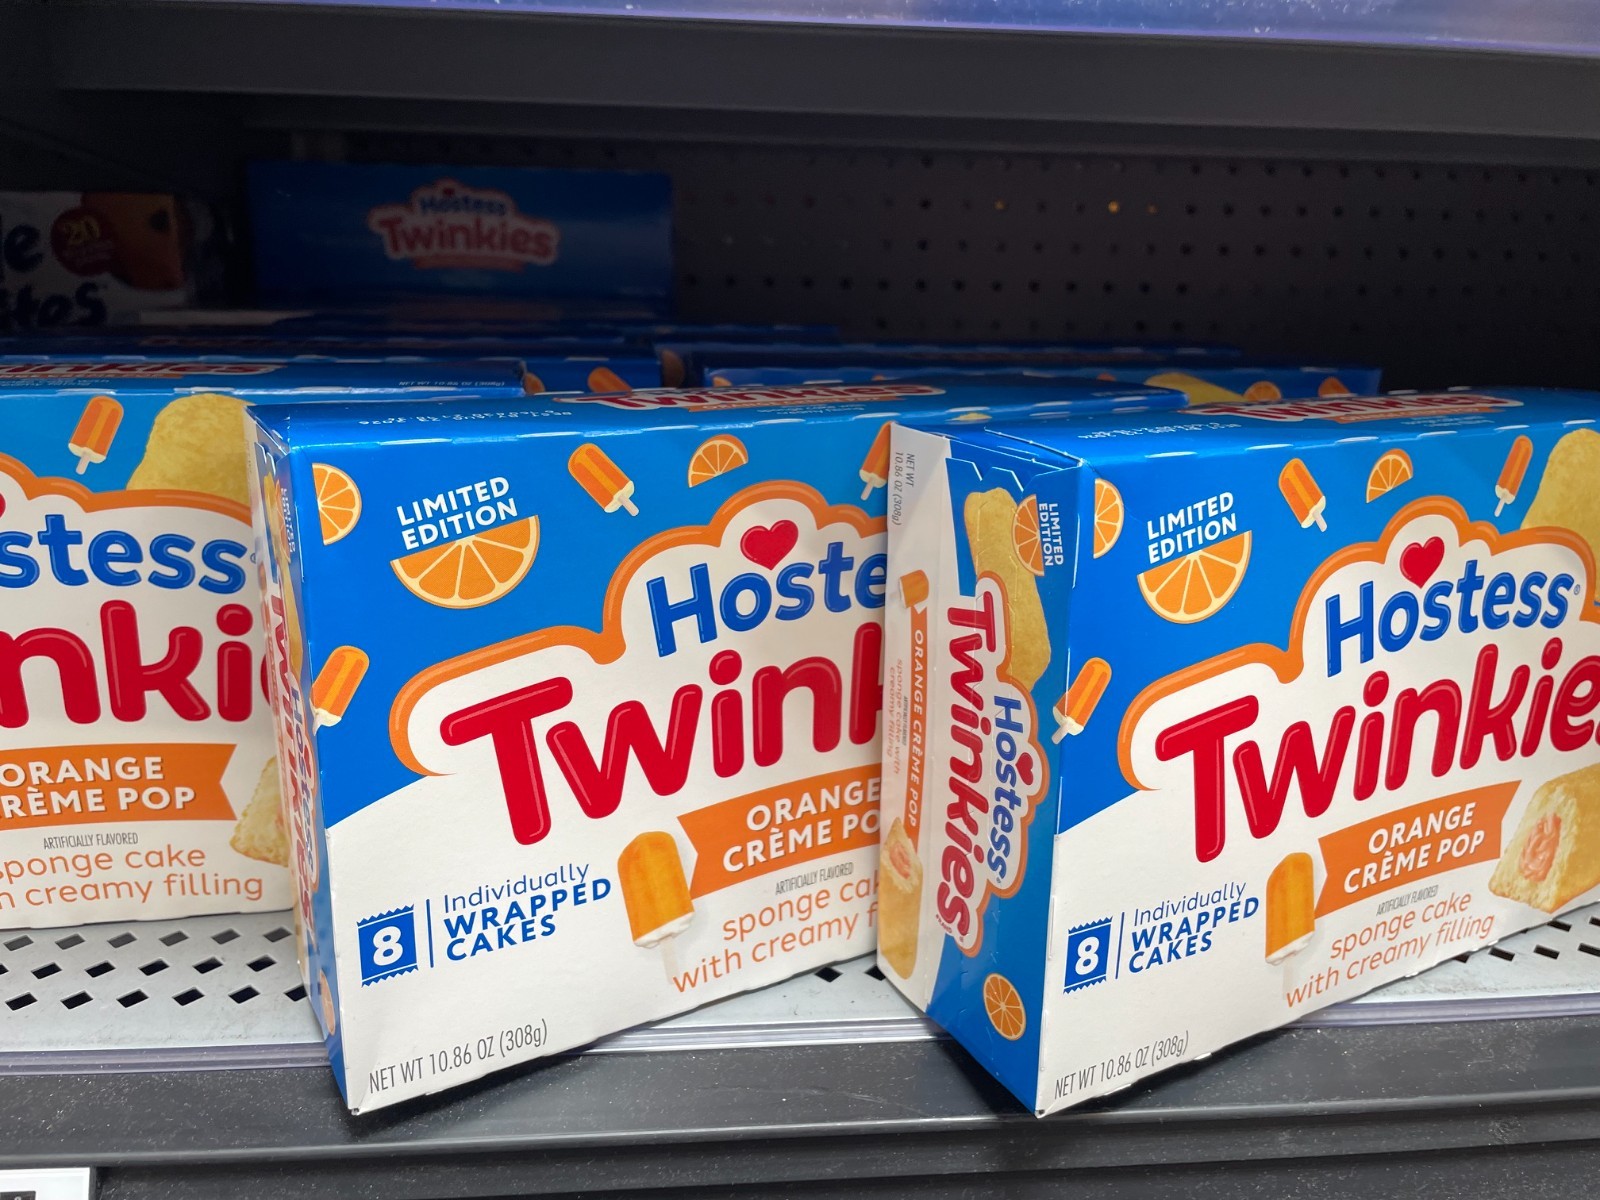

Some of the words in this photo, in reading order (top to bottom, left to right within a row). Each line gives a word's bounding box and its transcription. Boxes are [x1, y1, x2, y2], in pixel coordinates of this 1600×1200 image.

[63, 215, 102, 247] 20
[378, 215, 552, 257] Twinkies
[576, 384, 935, 408] Twinkies
[895, 451, 905, 478] 10.86
[895, 480, 904, 493] OZ
[905, 471, 915, 487] WT
[906, 452, 916, 471] NET
[396, 476, 510, 526] LIMITED
[402, 498, 518, 550] EDITION
[891, 493, 904, 527] (308g)
[1147, 491, 1234, 540] LIMITED
[0, 514, 248, 594] stess
[1038, 502, 1054, 567] EDITION
[1048, 503, 1064, 566] LIMITED
[1148, 513, 1237, 564] EDITION
[646, 541, 886, 658] Hoste
[1325, 559, 1575, 678] Hostess
[0, 600, 273, 728] nki
[912, 629, 925, 718] ORANGE
[894, 710, 904, 743] cake
[910, 719, 924, 781] CRÈME
[1155, 637, 1600, 862] Twinkie
[0, 756, 164, 787] ORANGE
[893, 745, 903, 775] with
[936, 590, 997, 937] Twinkies
[118, 786, 195, 811] POP
[746, 777, 881, 832] ORANGE
[908, 787, 919, 828] POP
[986, 695, 1024, 882] Hostess
[43, 834, 94, 850] ARTIFICIALLY
[96, 832, 139, 846] FLAVORED
[722, 819, 833, 873] CRÈME
[1367, 802, 1476, 855] ORANGE
[125, 844, 206, 869] cake
[775, 870, 818, 895] ARTIFICIALLY
[818, 861, 854, 886] FLAVORED
[1343, 843, 1432, 894] CRÈME
[1436, 830, 1485, 864] POP
[25, 880, 153, 906] creamy
[163, 873, 263, 901] filling
[443, 863, 590, 914] Individually
[443, 878, 611, 939] WRAPPED
[1134, 881, 1247, 927] Individually
[1376, 892, 1412, 916] ARTIFICIALLY
[1410, 885, 1439, 905] FLAVORED
[446, 914, 556, 961] CAKES
[722, 887, 831, 942] sponge
[1131, 896, 1260, 951] WRAPPED
[1330, 910, 1416, 960] sponge
[1421, 892, 1472, 923] cake
[373, 925, 403, 966] 8
[672, 949, 742, 993] with
[751, 911, 860, 963] creamy
[1074, 936, 1100, 975] 8
[1128, 930, 1213, 973] CAKES
[1286, 966, 1339, 1008] with
[1346, 931, 1432, 980] creamy
[1435, 914, 1495, 947] filling
[369, 1065, 396, 1094] NET
[400, 1057, 424, 1084] WT
[430, 1043, 471, 1075] 10.86
[476, 1036, 495, 1059] OZ
[499, 1018, 549, 1058] (308g)
[1054, 1072, 1076, 1100] NET
[1078, 1064, 1097, 1089] WT
[1100, 1051, 1132, 1082] 10.86
[1135, 1045, 1151, 1069] OZ
[1151, 1029, 1190, 1067] (308g)
